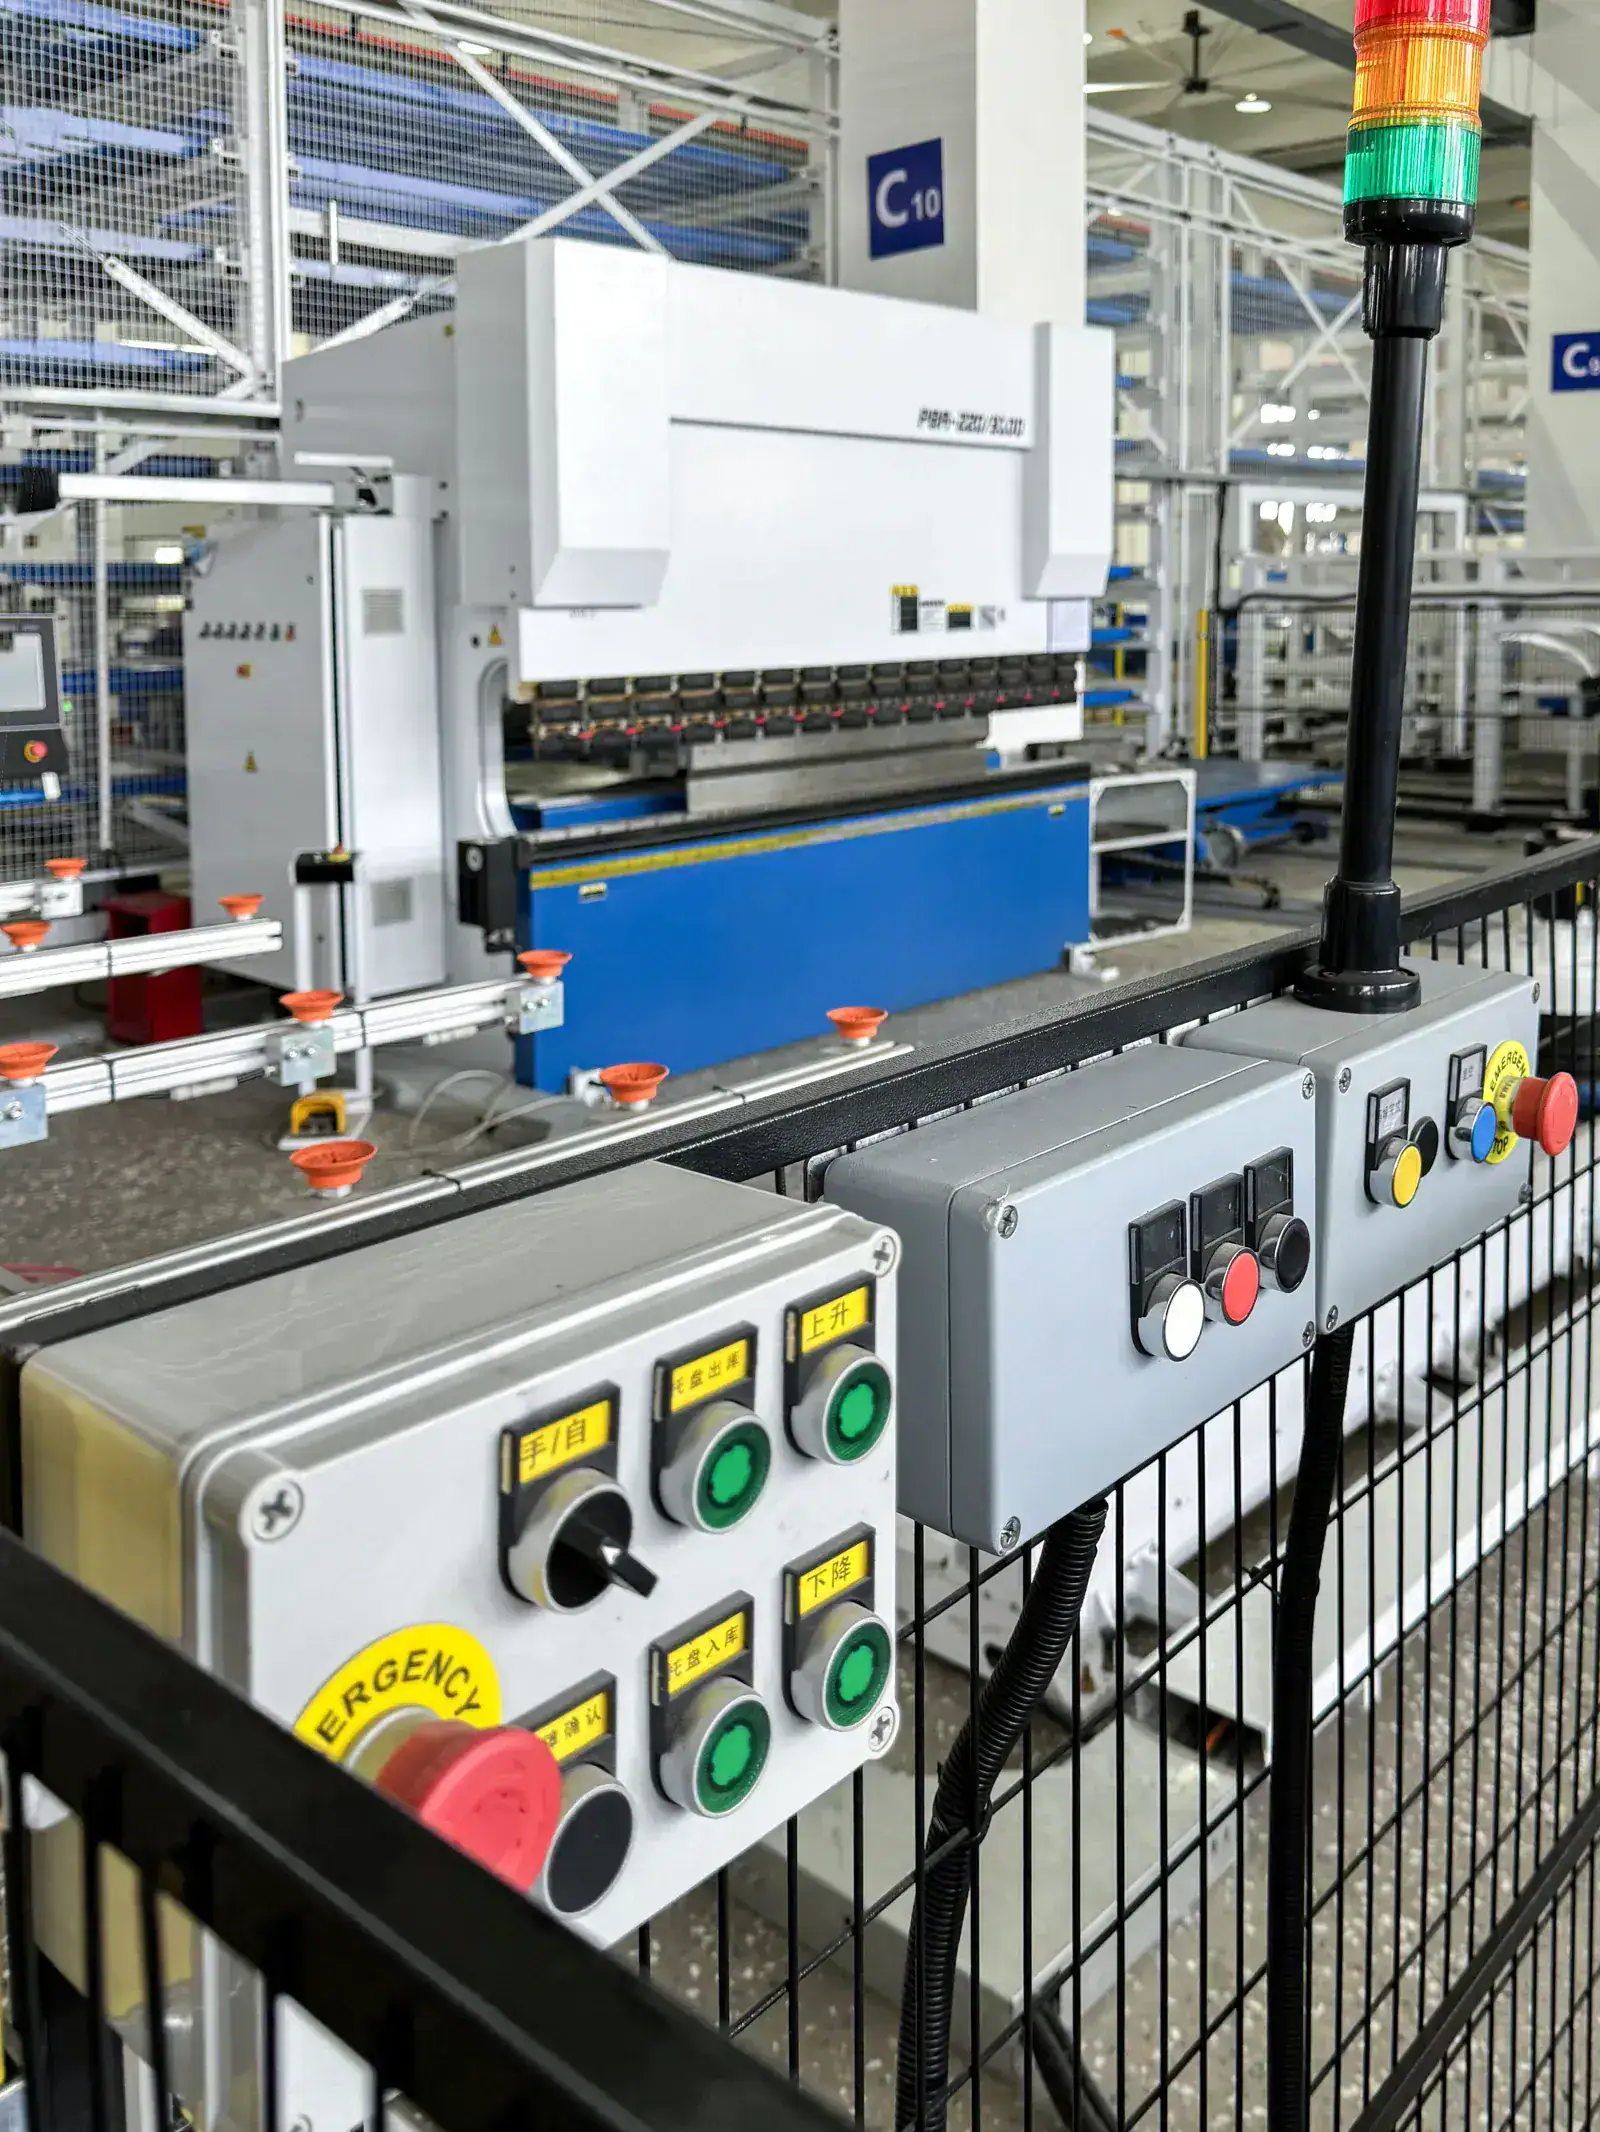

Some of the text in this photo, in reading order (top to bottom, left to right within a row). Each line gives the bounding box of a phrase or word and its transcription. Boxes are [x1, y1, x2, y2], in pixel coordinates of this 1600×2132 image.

[1489, 1050, 1528, 1092] EMERGEN
[806, 1300, 850, 1341] 上升
[520, 1418, 586, 1471] 手/自
[806, 1555, 851, 1598] 下降
[315, 1648, 481, 1744] ERGENCY
